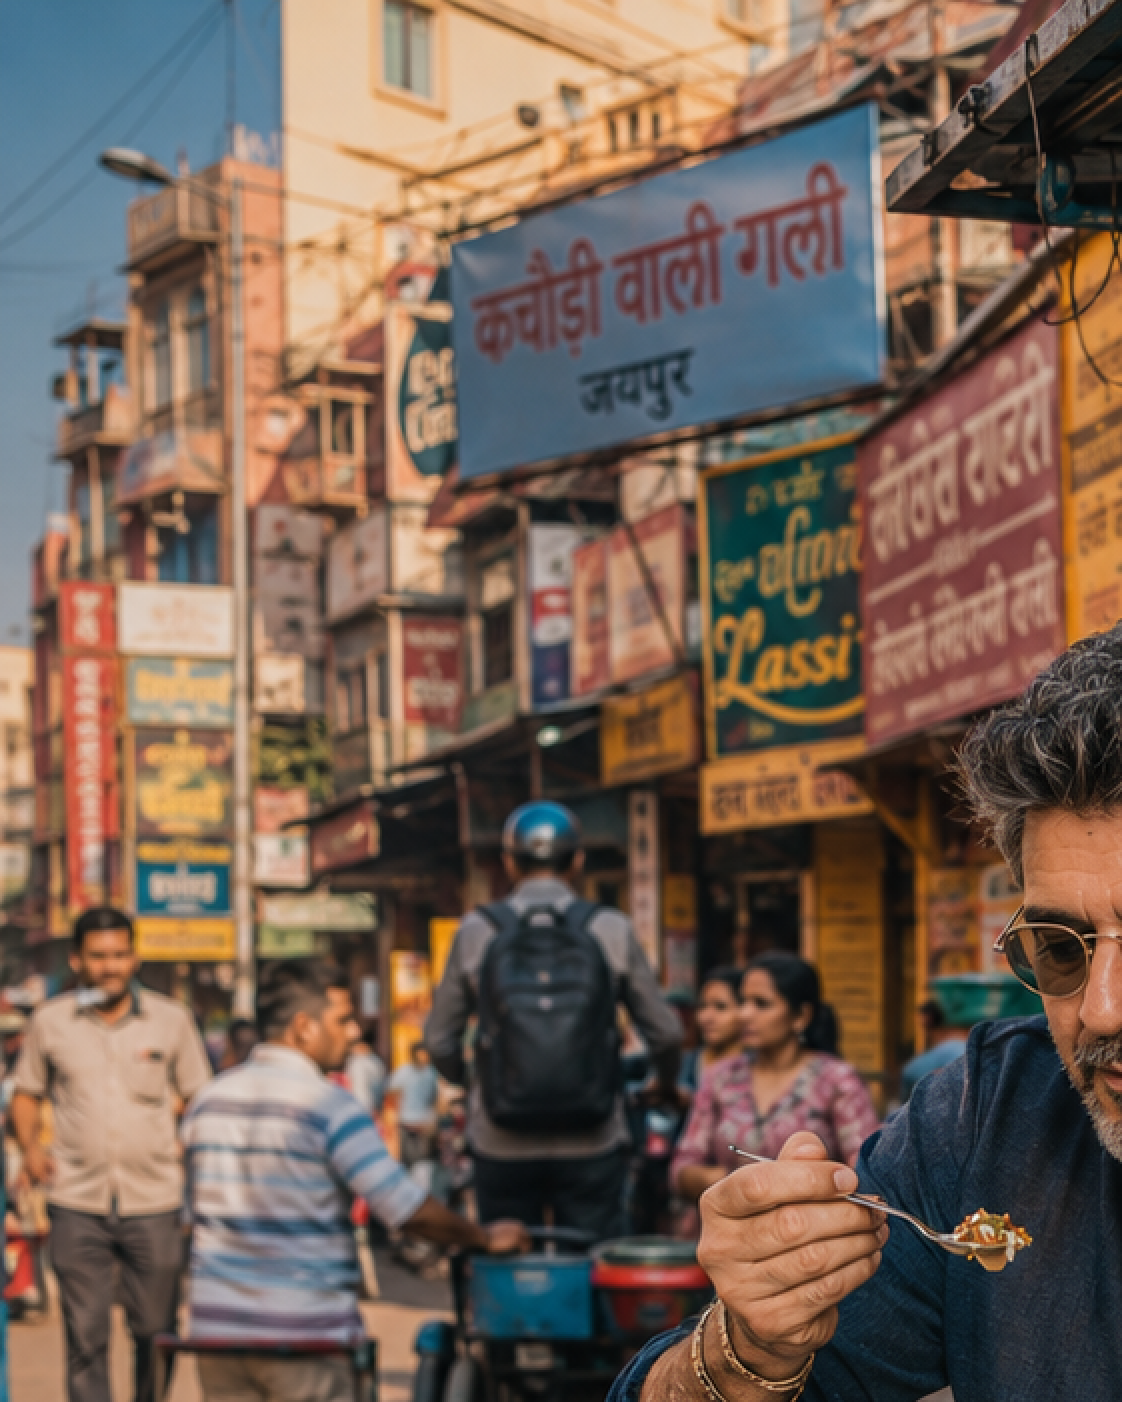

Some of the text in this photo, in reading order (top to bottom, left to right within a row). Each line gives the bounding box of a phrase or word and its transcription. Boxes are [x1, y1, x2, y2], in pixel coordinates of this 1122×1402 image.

[469, 161, 848, 362] कचौड़ी वाली गली
[579, 348, 694, 420] जयपुर
[714, 606, 855, 712] Lassi
